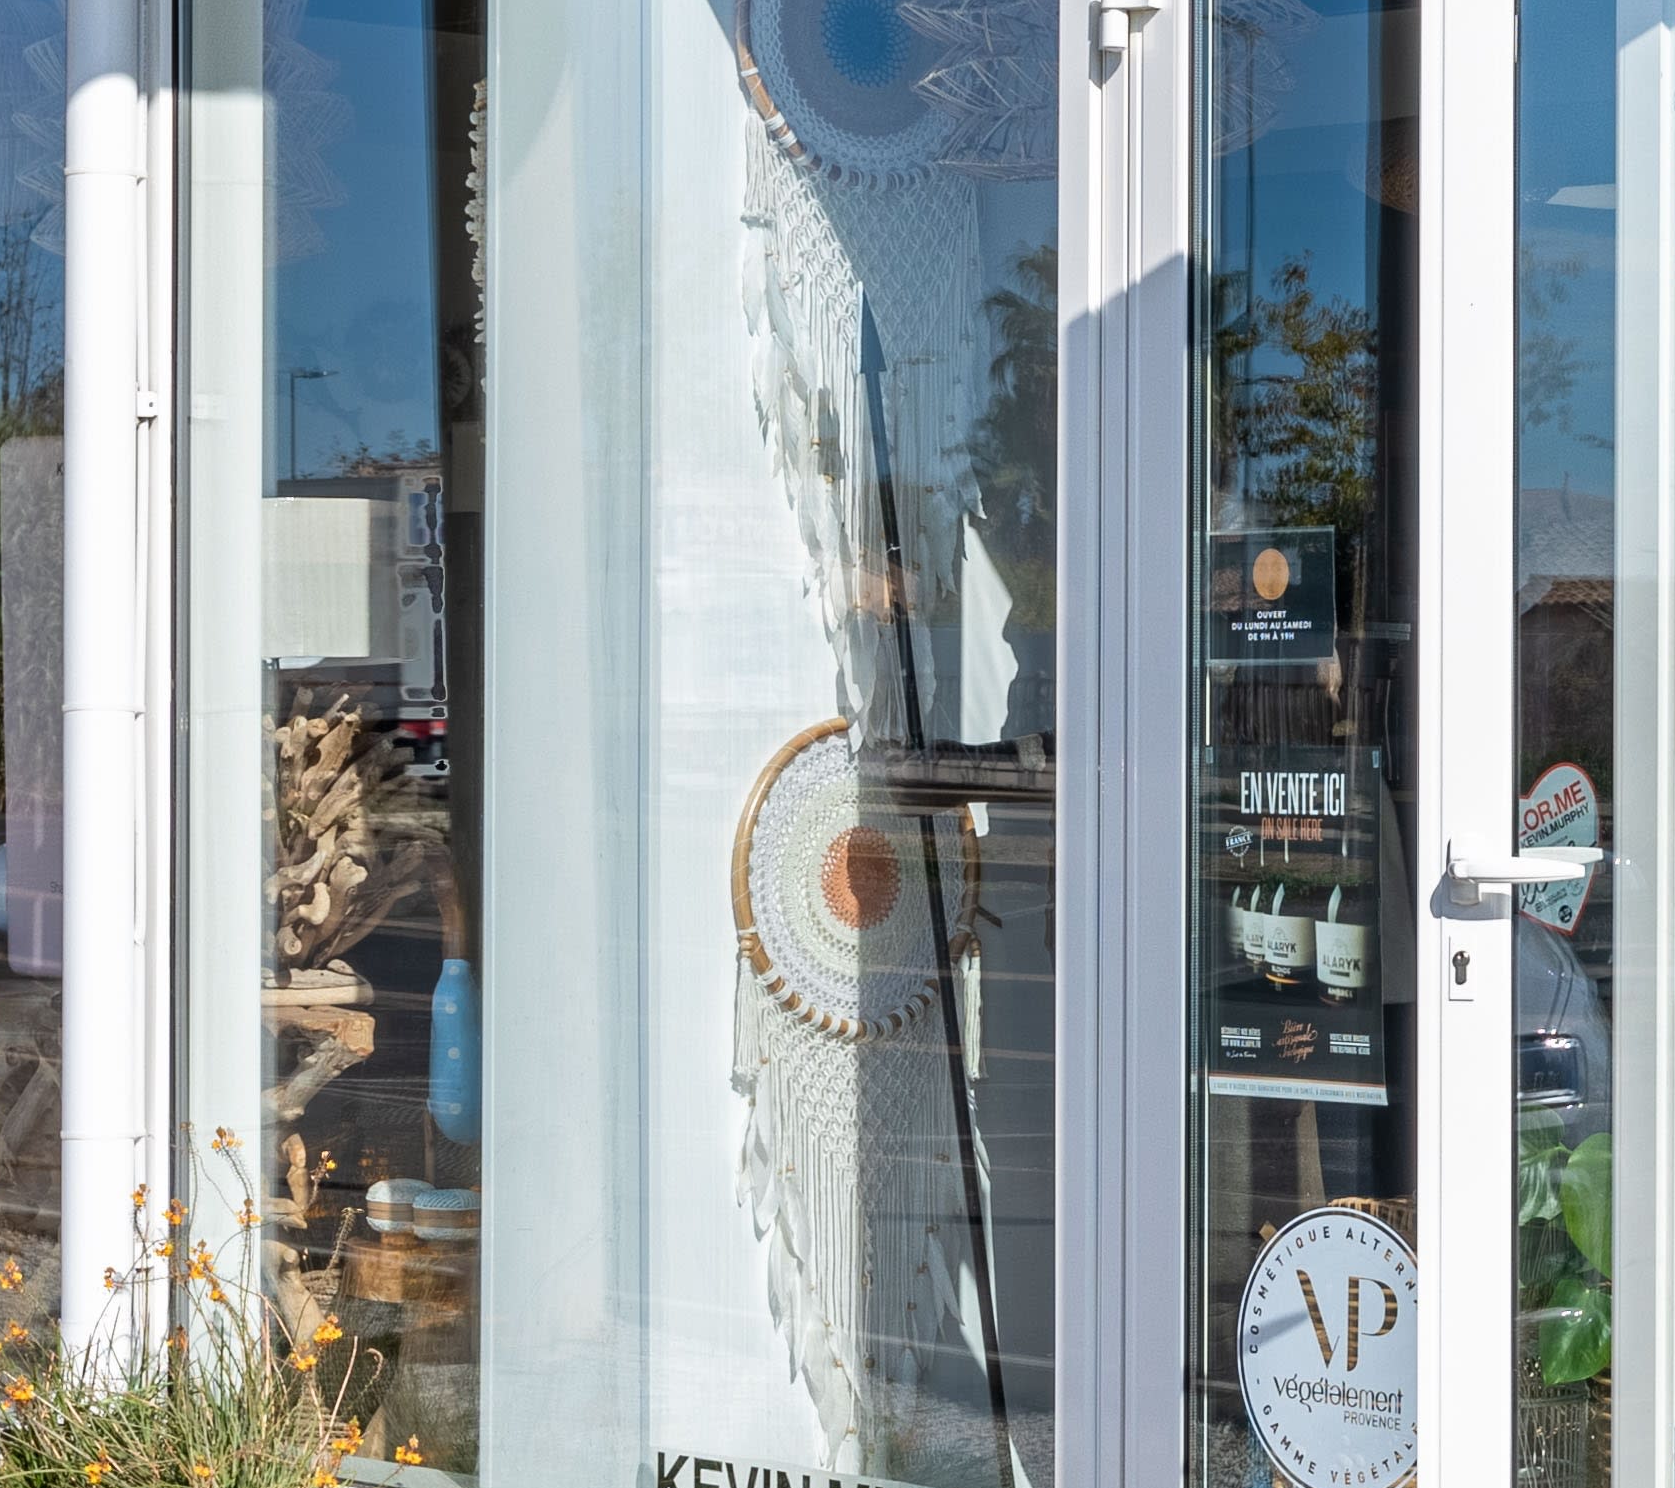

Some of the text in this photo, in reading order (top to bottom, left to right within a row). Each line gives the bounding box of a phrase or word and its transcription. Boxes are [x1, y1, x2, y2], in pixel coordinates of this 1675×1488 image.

[1231, 620, 1312, 631] DU LUNDI AU SAMEDI
[1256, 610, 1287, 619] OUVERT
[1247, 632, 1258, 641] DE
[1240, 771, 1346, 816] EN VENTE ICI
[1519, 779, 1587, 837] OR.ME
[1260, 816, 1323, 842] ON SALE HERE
[1249, 1225, 1417, 1355] COSMÉTIQUE ALTERN
[1343, 1411, 1402, 1431] PROVENCE
[1262, 1404, 1318, 1475] GAMME
